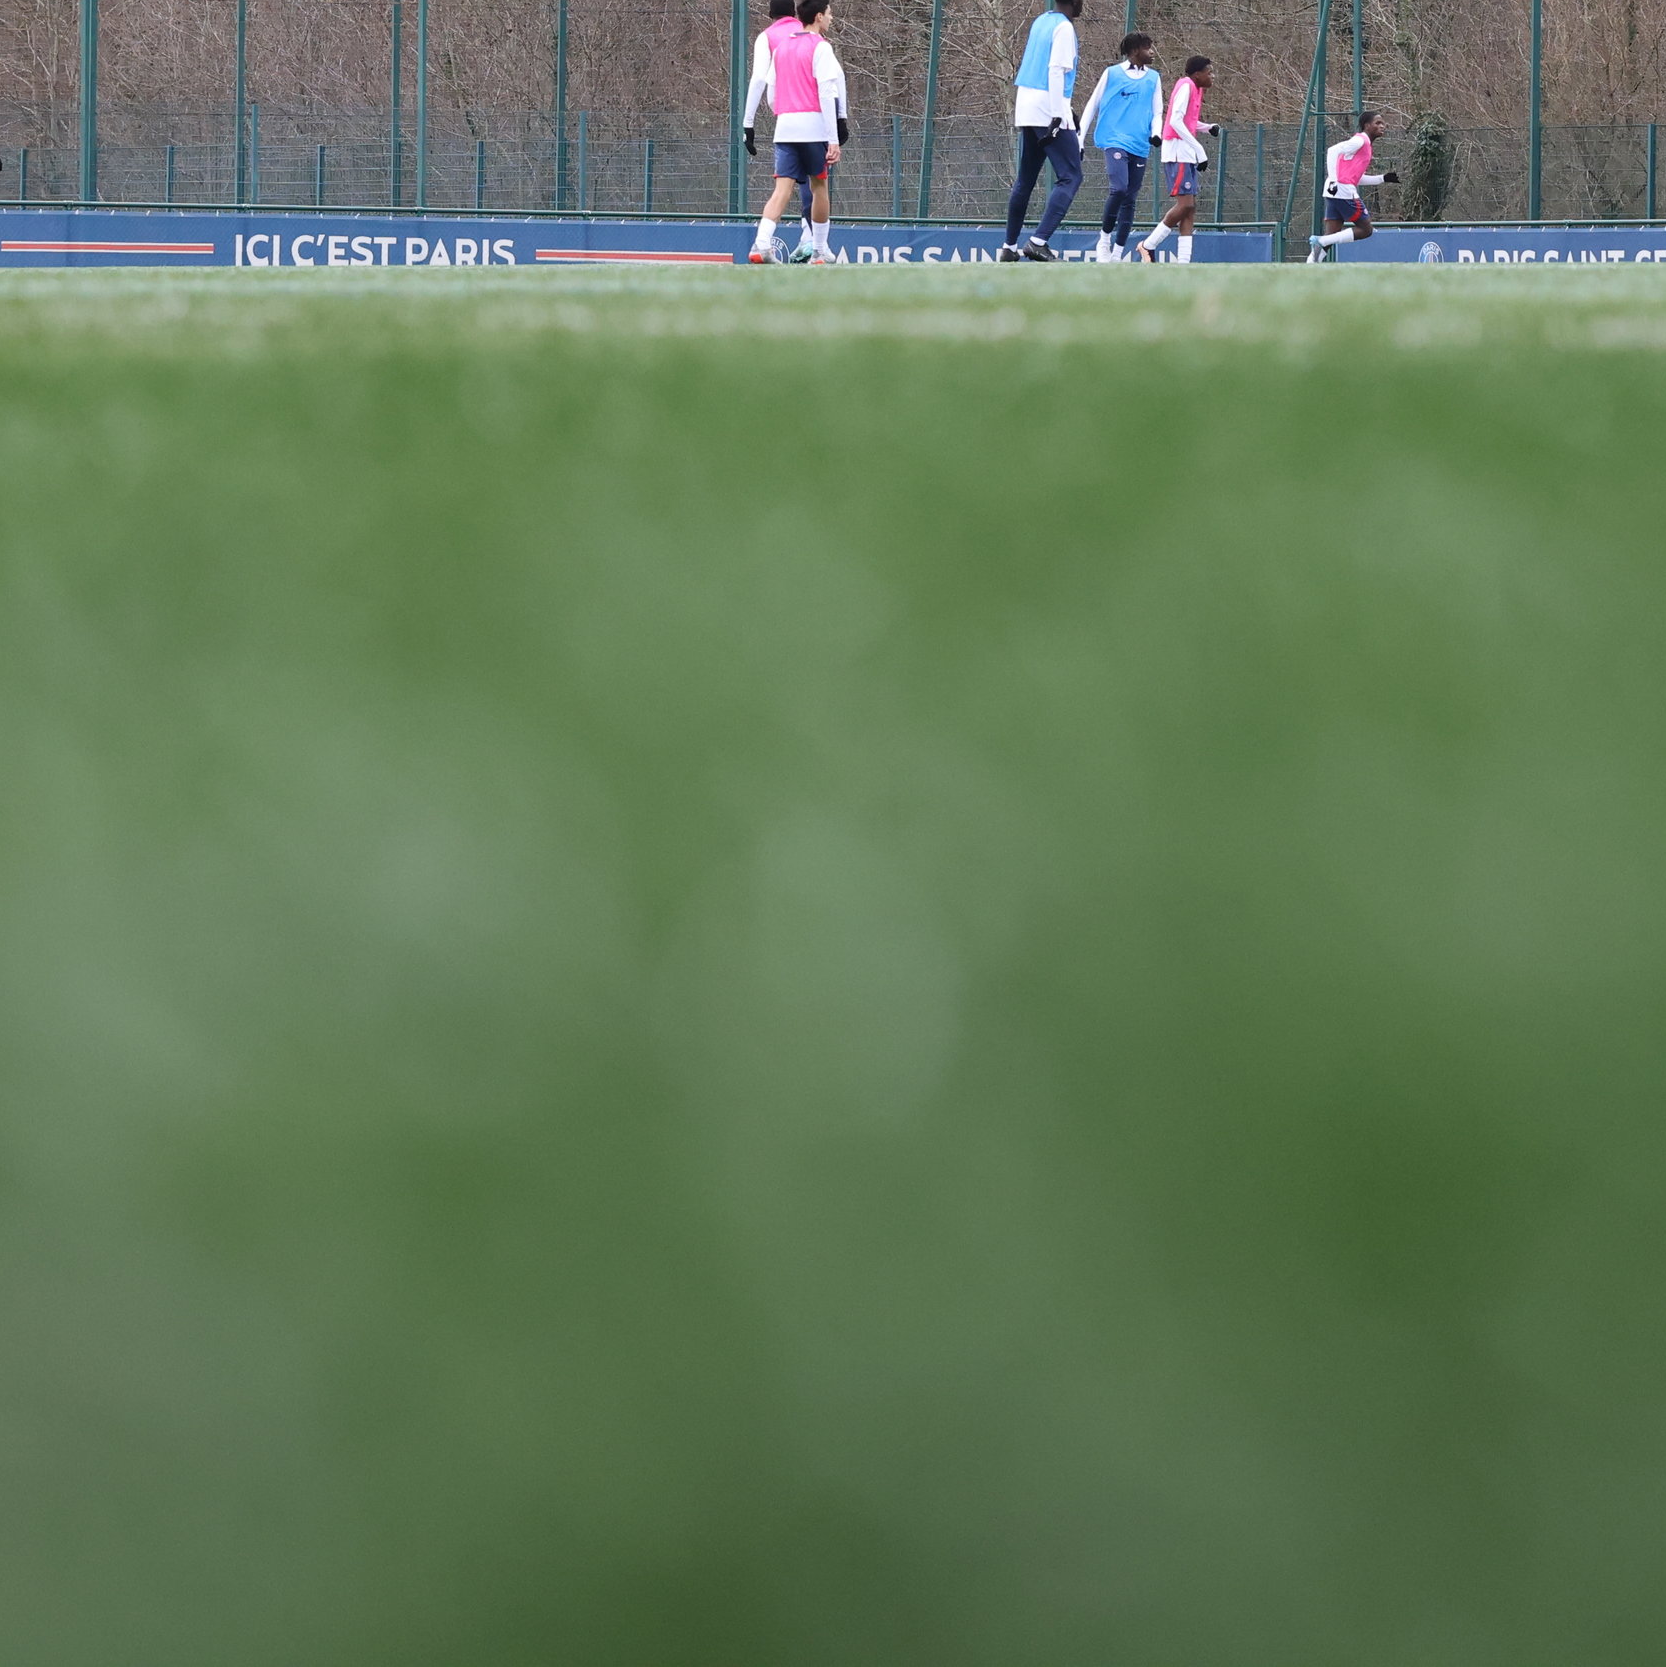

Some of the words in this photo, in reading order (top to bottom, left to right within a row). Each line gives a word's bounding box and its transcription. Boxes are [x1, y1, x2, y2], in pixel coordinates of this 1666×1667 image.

[235, 234, 281, 266] ICI
[291, 234, 397, 266] C'EST
[405, 237, 516, 266] PARIS
